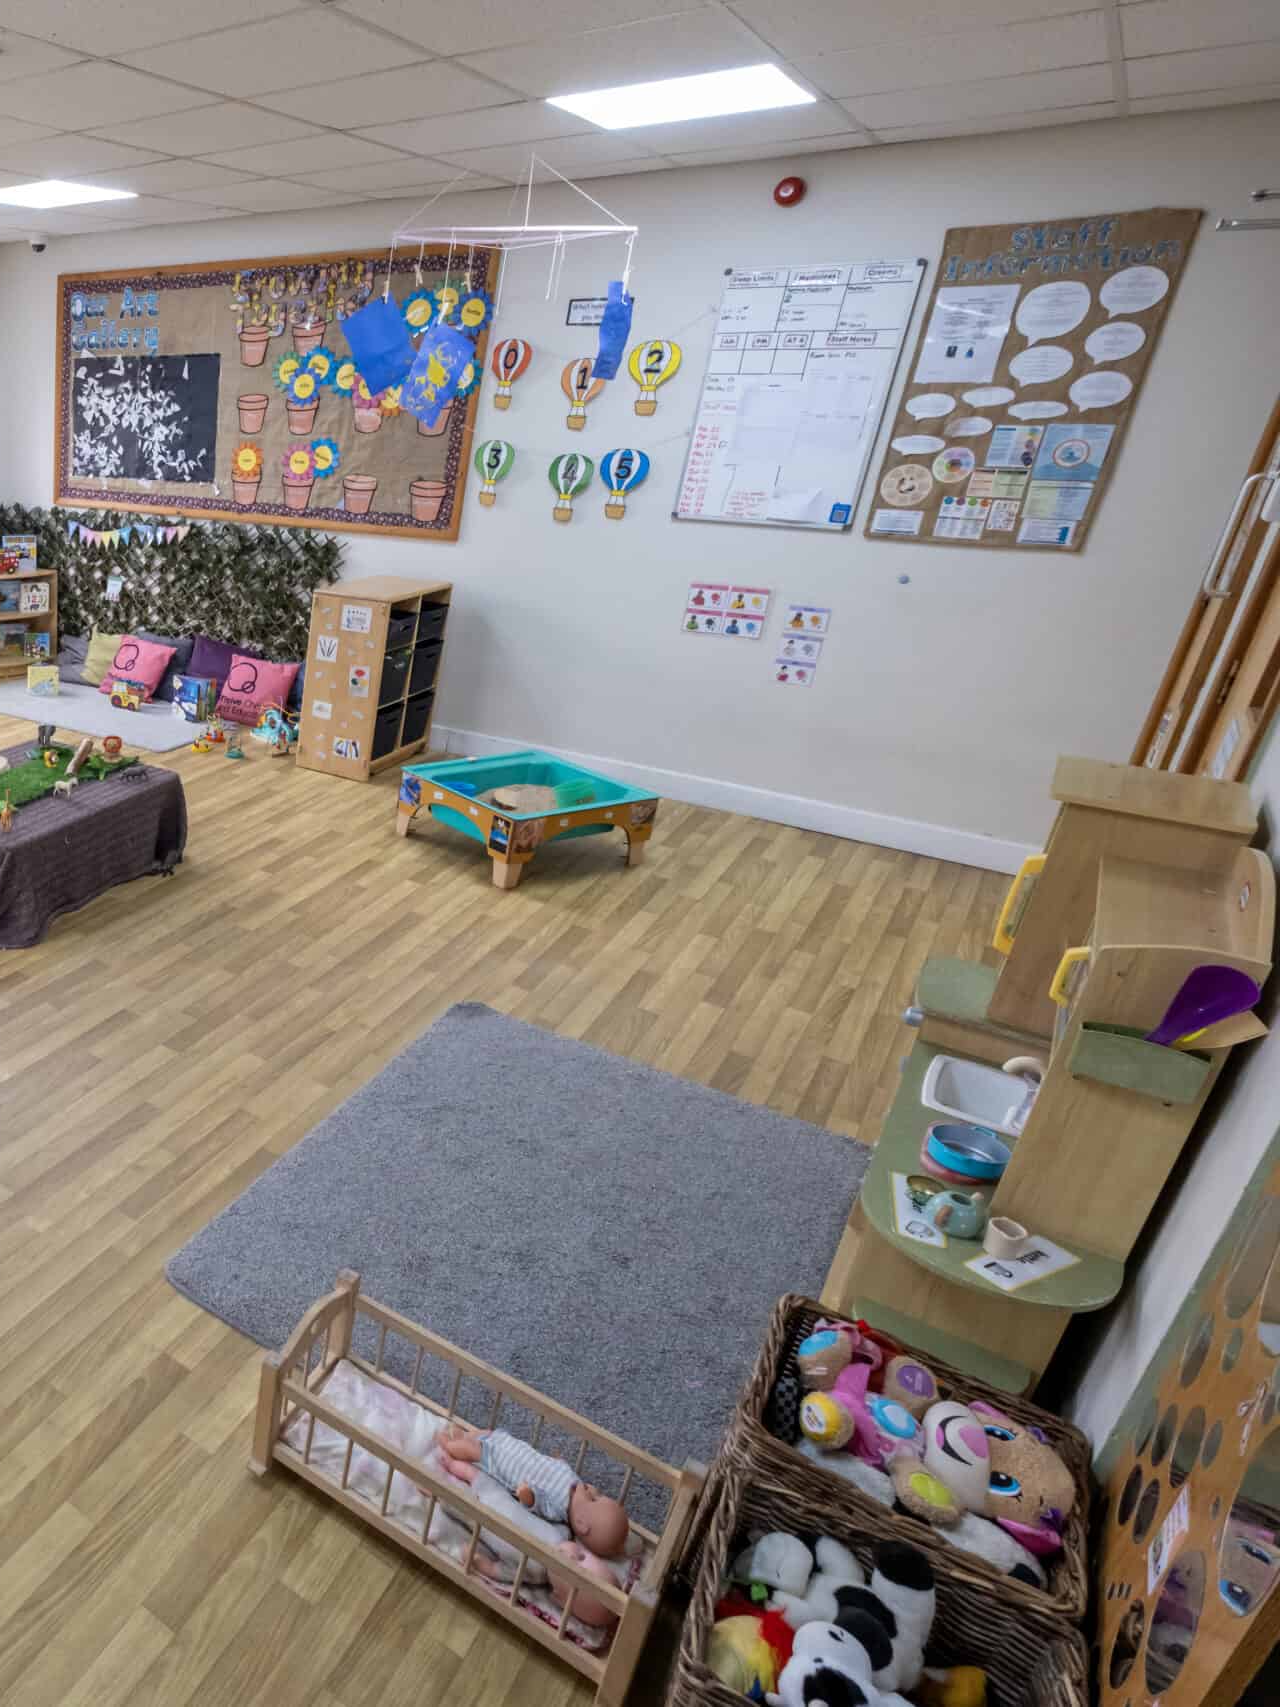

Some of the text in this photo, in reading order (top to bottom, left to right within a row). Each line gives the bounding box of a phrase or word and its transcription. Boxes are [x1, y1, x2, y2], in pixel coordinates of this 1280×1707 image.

[1012, 216, 1118, 250] Staff
[943, 239, 1181, 281] Information
[70, 286, 160, 321] Our Art
[70, 318, 160, 358] Gallery
[502, 348, 519, 370] 0
[643, 349, 664, 374] 2
[576, 367, 589, 390] 1
[486, 448, 503, 470] 3
[614, 457, 634, 480] 5
[560, 463, 578, 484] 4
